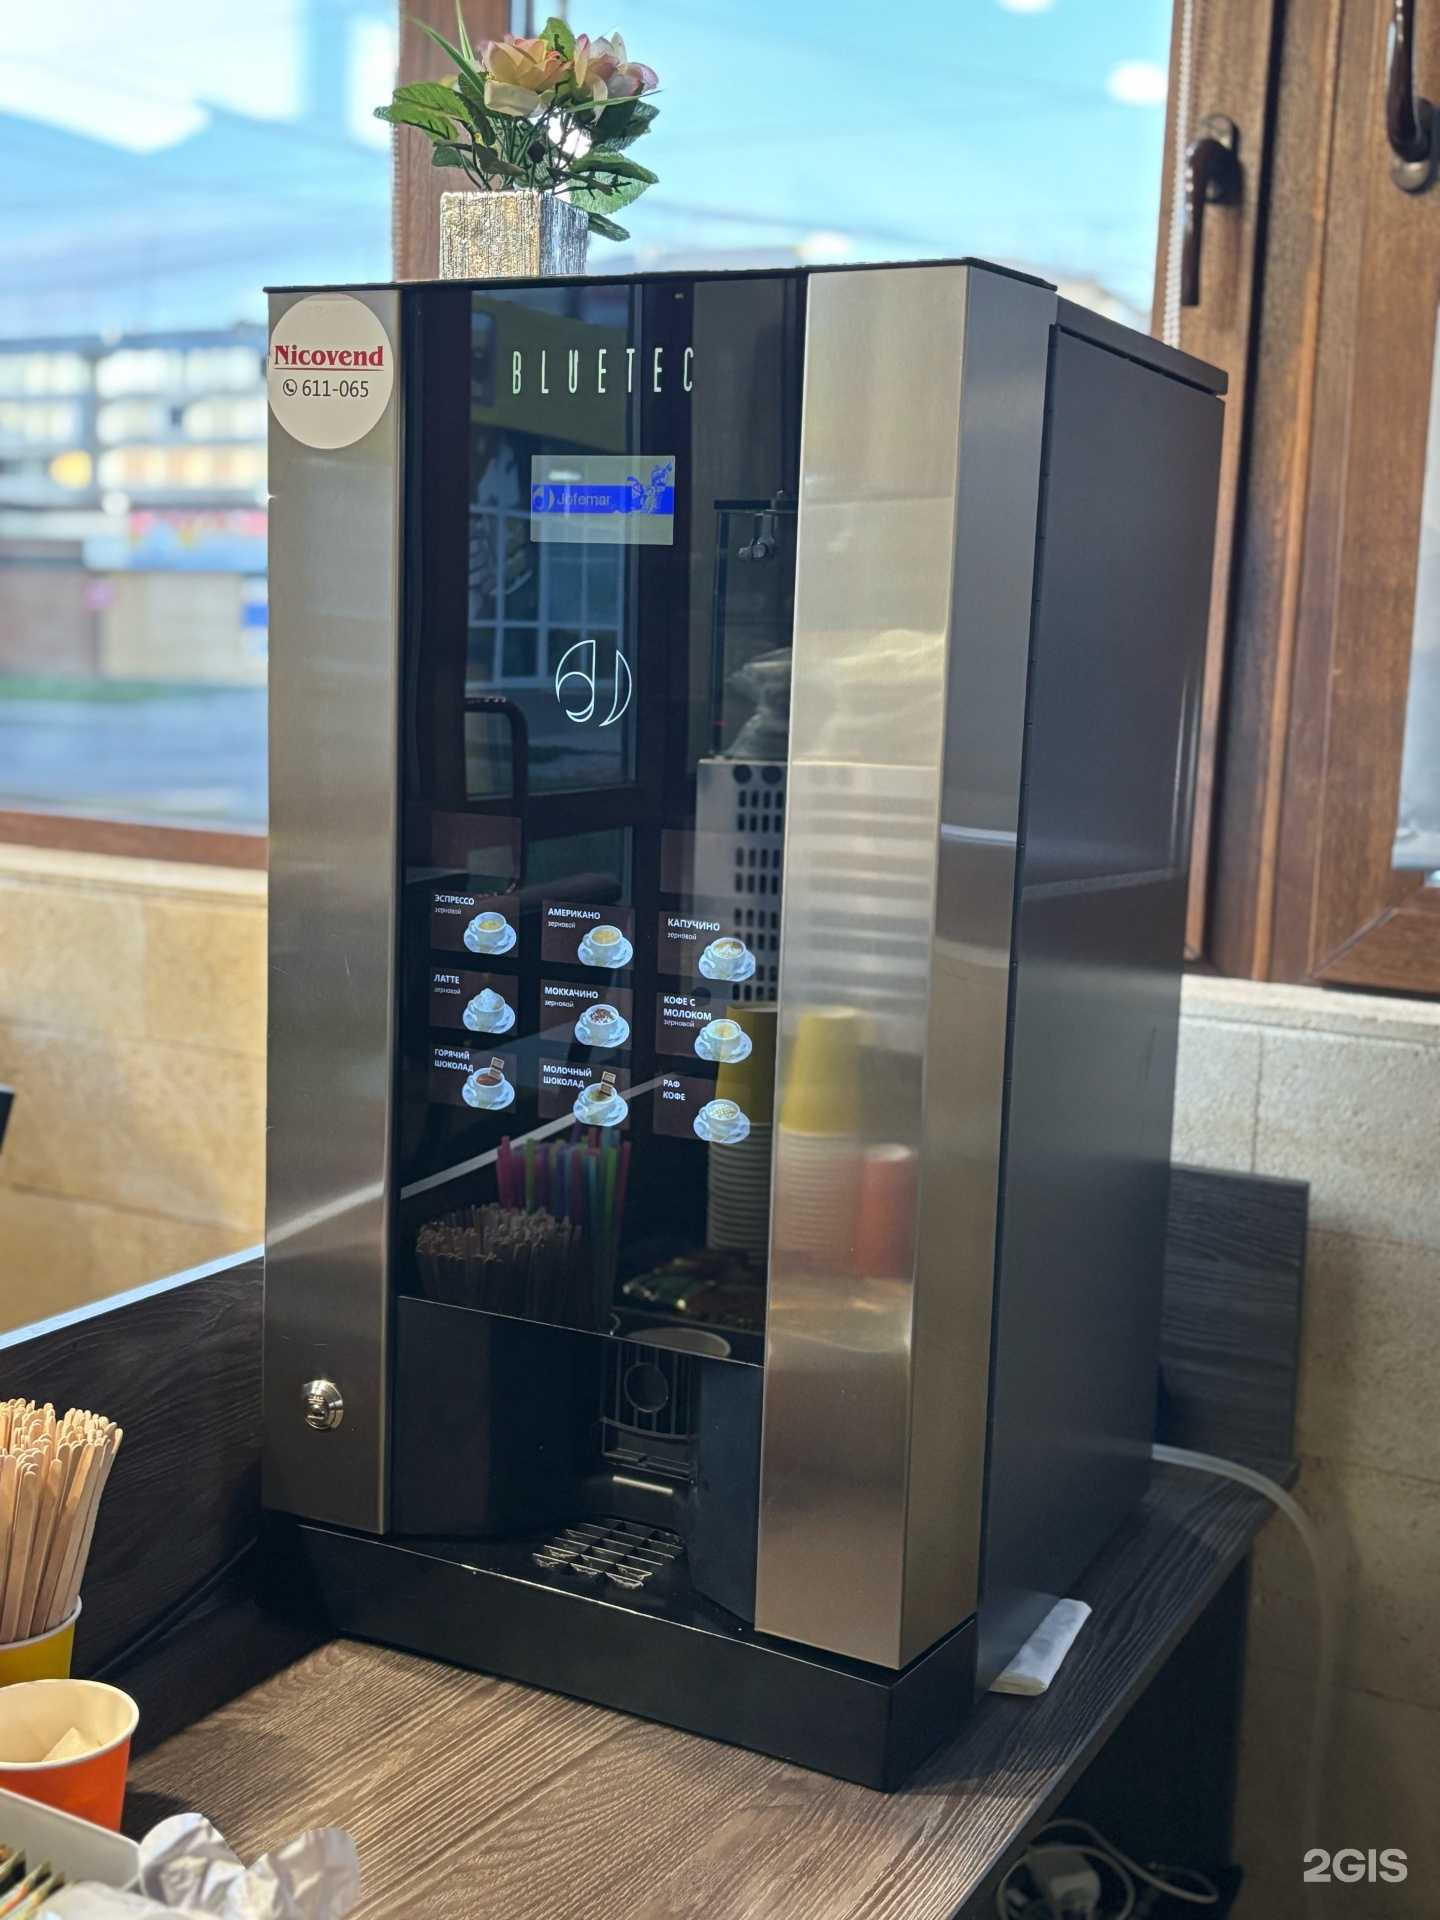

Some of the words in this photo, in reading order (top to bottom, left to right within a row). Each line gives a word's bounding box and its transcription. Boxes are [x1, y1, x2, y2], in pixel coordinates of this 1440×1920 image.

[274, 344, 384, 367] Nicovend
[512, 347, 694, 394] BLUETEC
[302, 379, 369, 398] 611-065
[434, 894, 475, 906] ЭСПРЕССО
[548, 907, 601, 920] АМЕРИКАНО
[667, 917, 720, 932] КАПУЧИНО
[433, 974, 460, 985] ЛАТТЕ
[544, 986, 599, 999] МОККАЧИНО
[663, 995, 688, 1006] КОФЕ
[663, 1008, 712, 1021] МОЛОКОМ
[434, 1048, 470, 1061] ГОРЯЧИЙ
[434, 1060, 474, 1073] ШОКОЛАД
[543, 1064, 592, 1077] МОЛОЧНЫЙ
[543, 1076, 585, 1089] ШОКОЛАД
[663, 1079, 681, 1089] РАФ
[662, 1090, 686, 1101] КОФЕ
